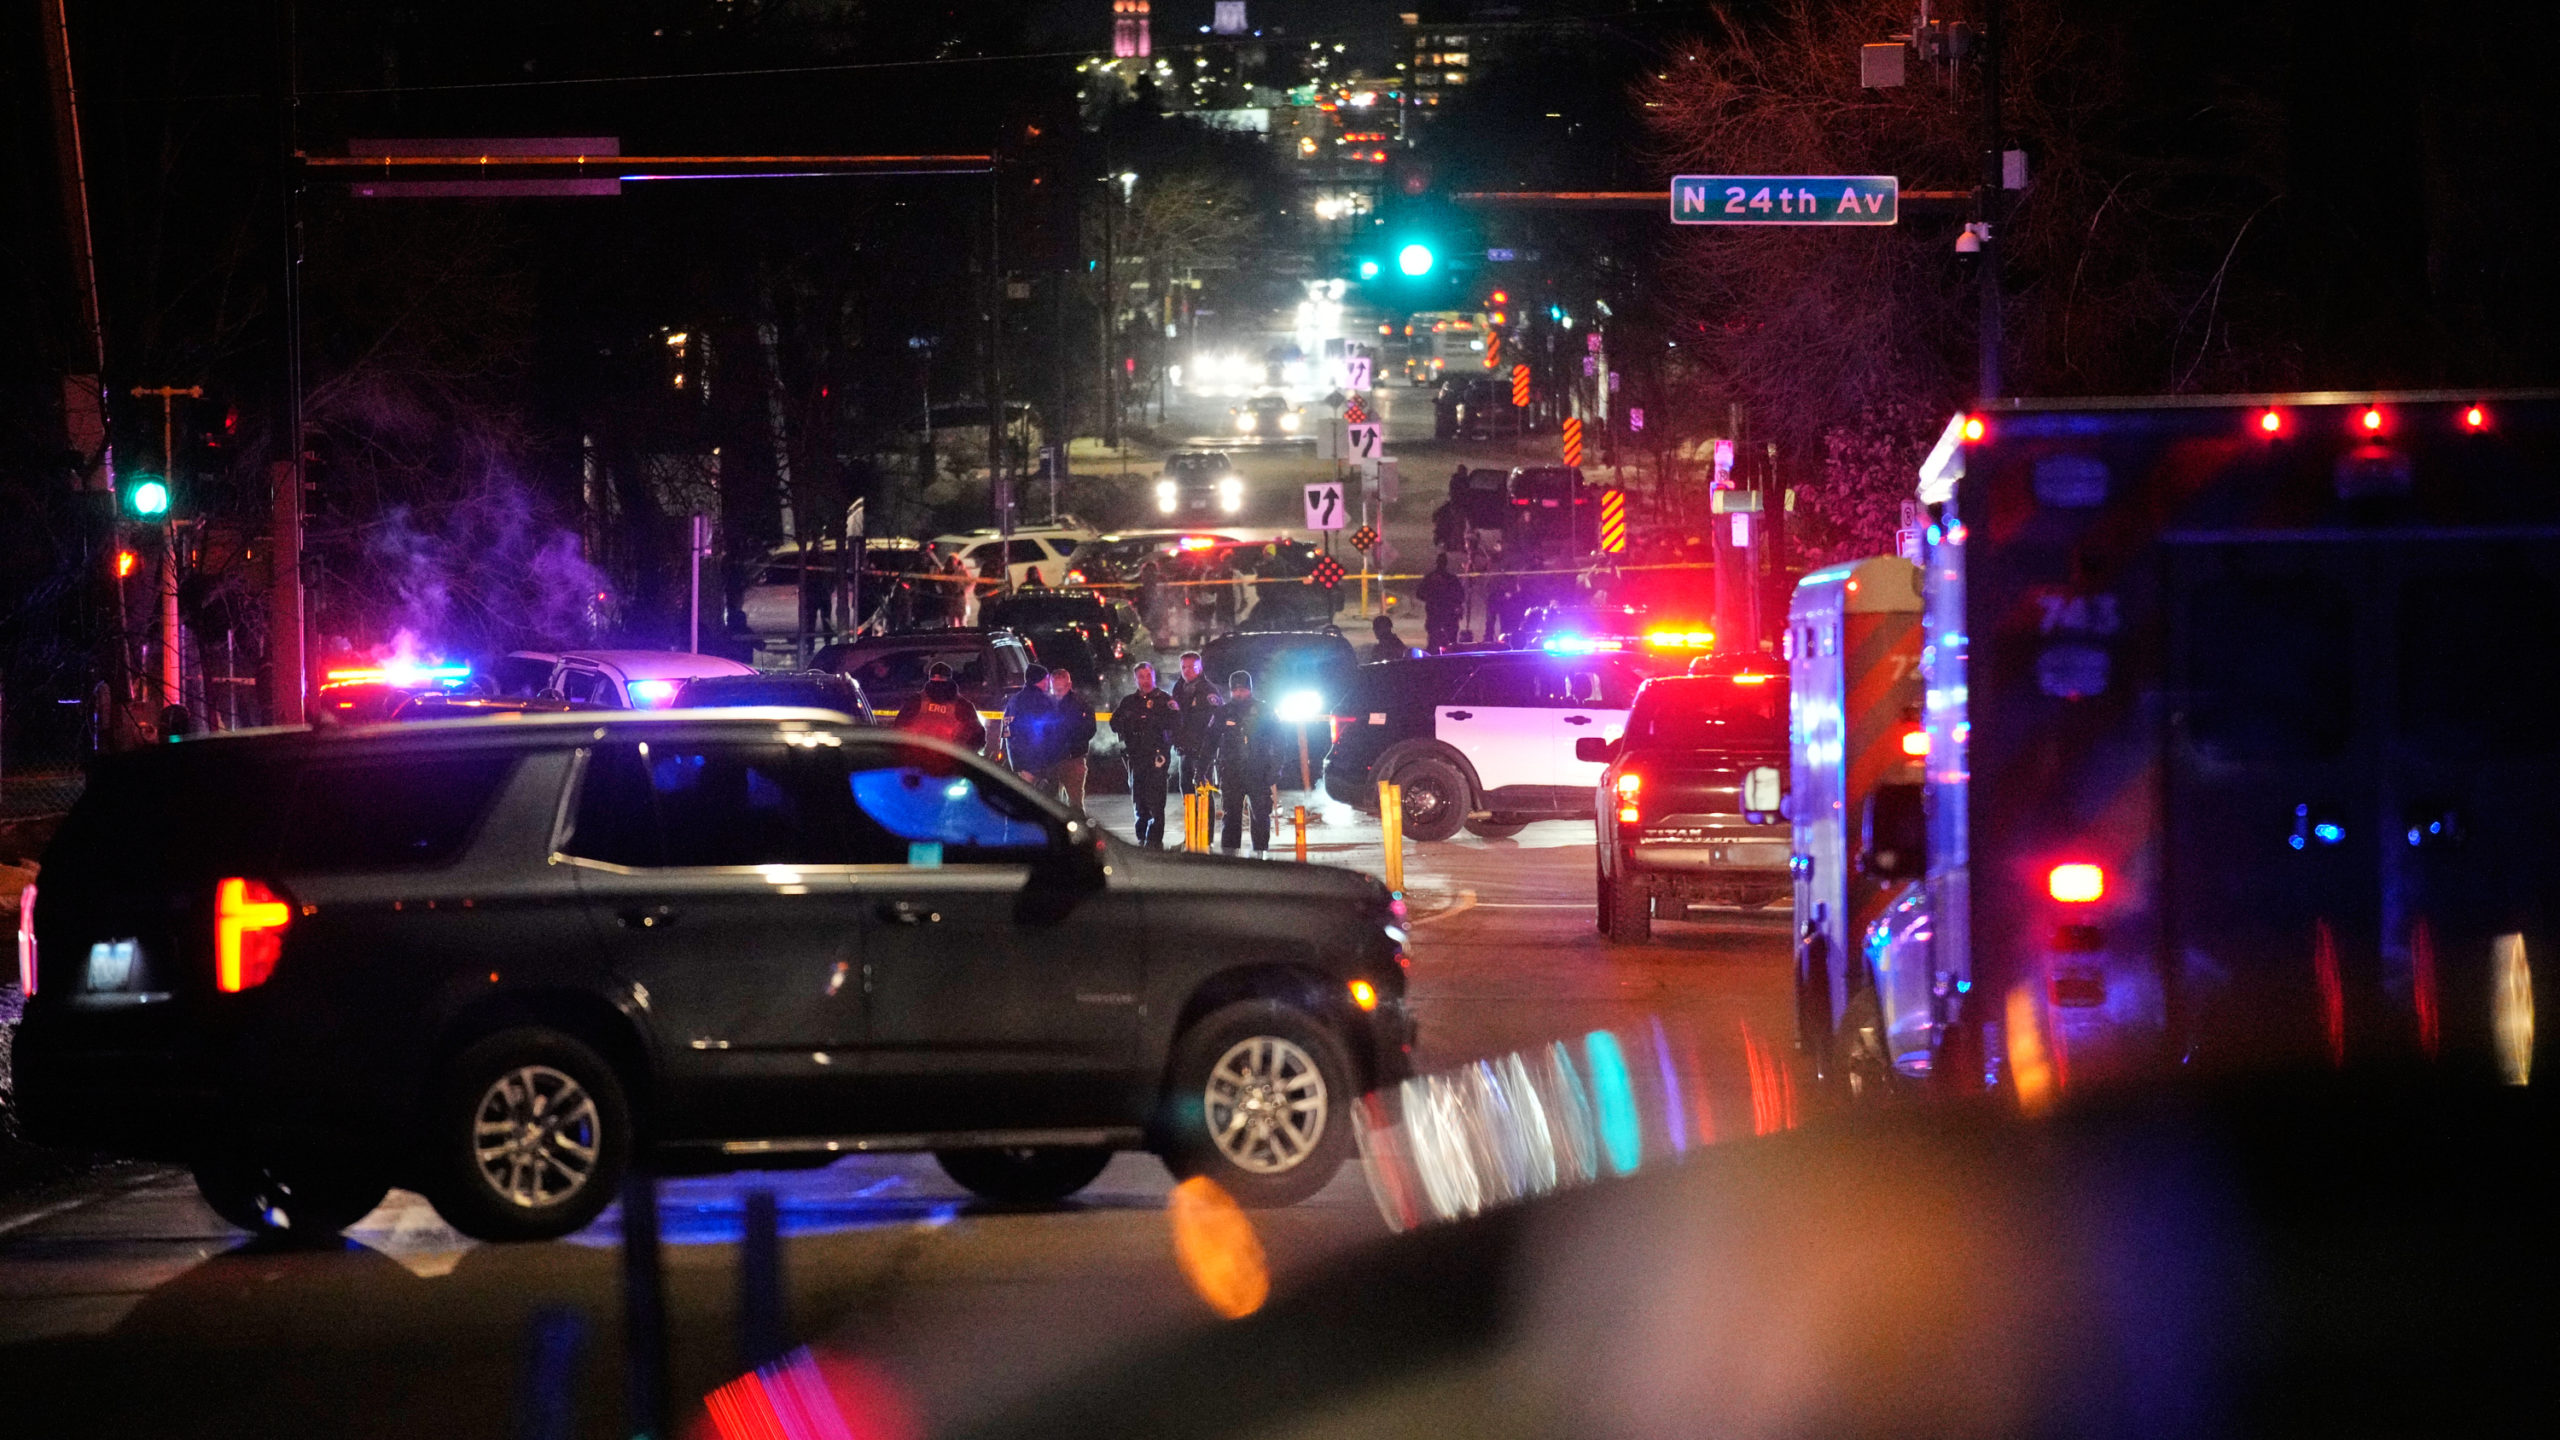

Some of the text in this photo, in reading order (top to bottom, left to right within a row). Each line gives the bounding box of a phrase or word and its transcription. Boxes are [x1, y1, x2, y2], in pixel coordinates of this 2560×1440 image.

[1683, 186, 1885, 213] N 24th Av
[2037, 594, 2119, 635] 743
[928, 703, 947, 714] ERO
